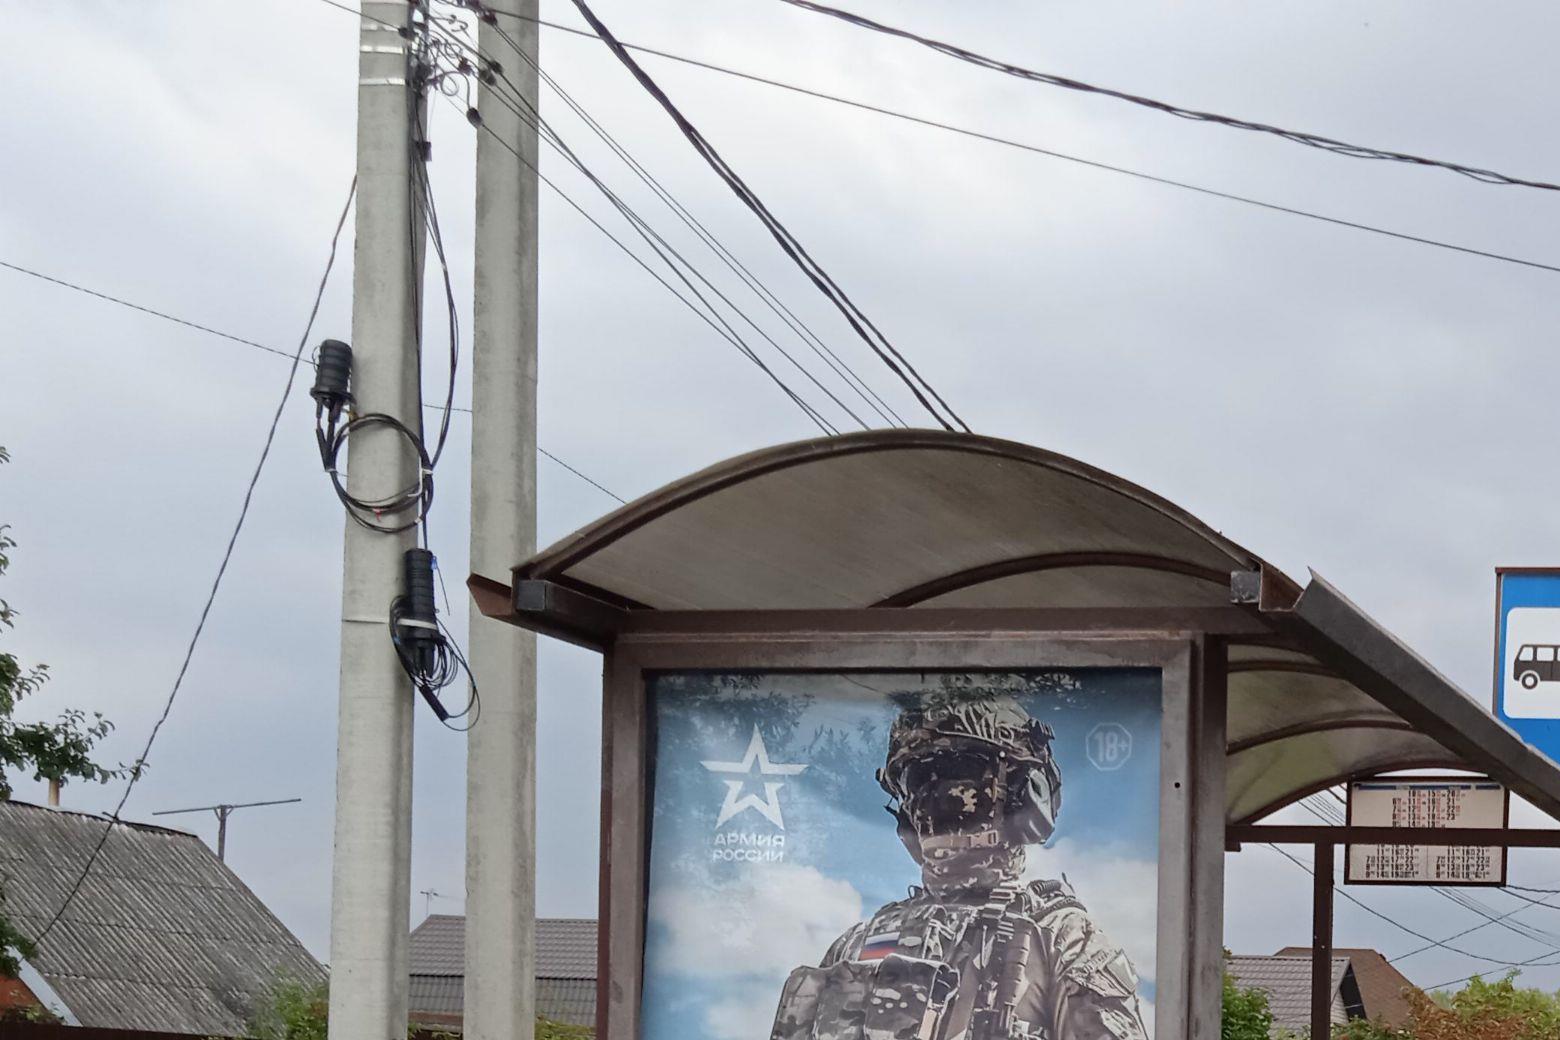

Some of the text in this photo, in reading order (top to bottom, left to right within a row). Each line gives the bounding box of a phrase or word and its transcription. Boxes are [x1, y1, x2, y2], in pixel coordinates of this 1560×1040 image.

[1093, 731, 1128, 762] 18+
[714, 832, 785, 848] АРМИЯ
[712, 848, 785, 863] РОССИИ
